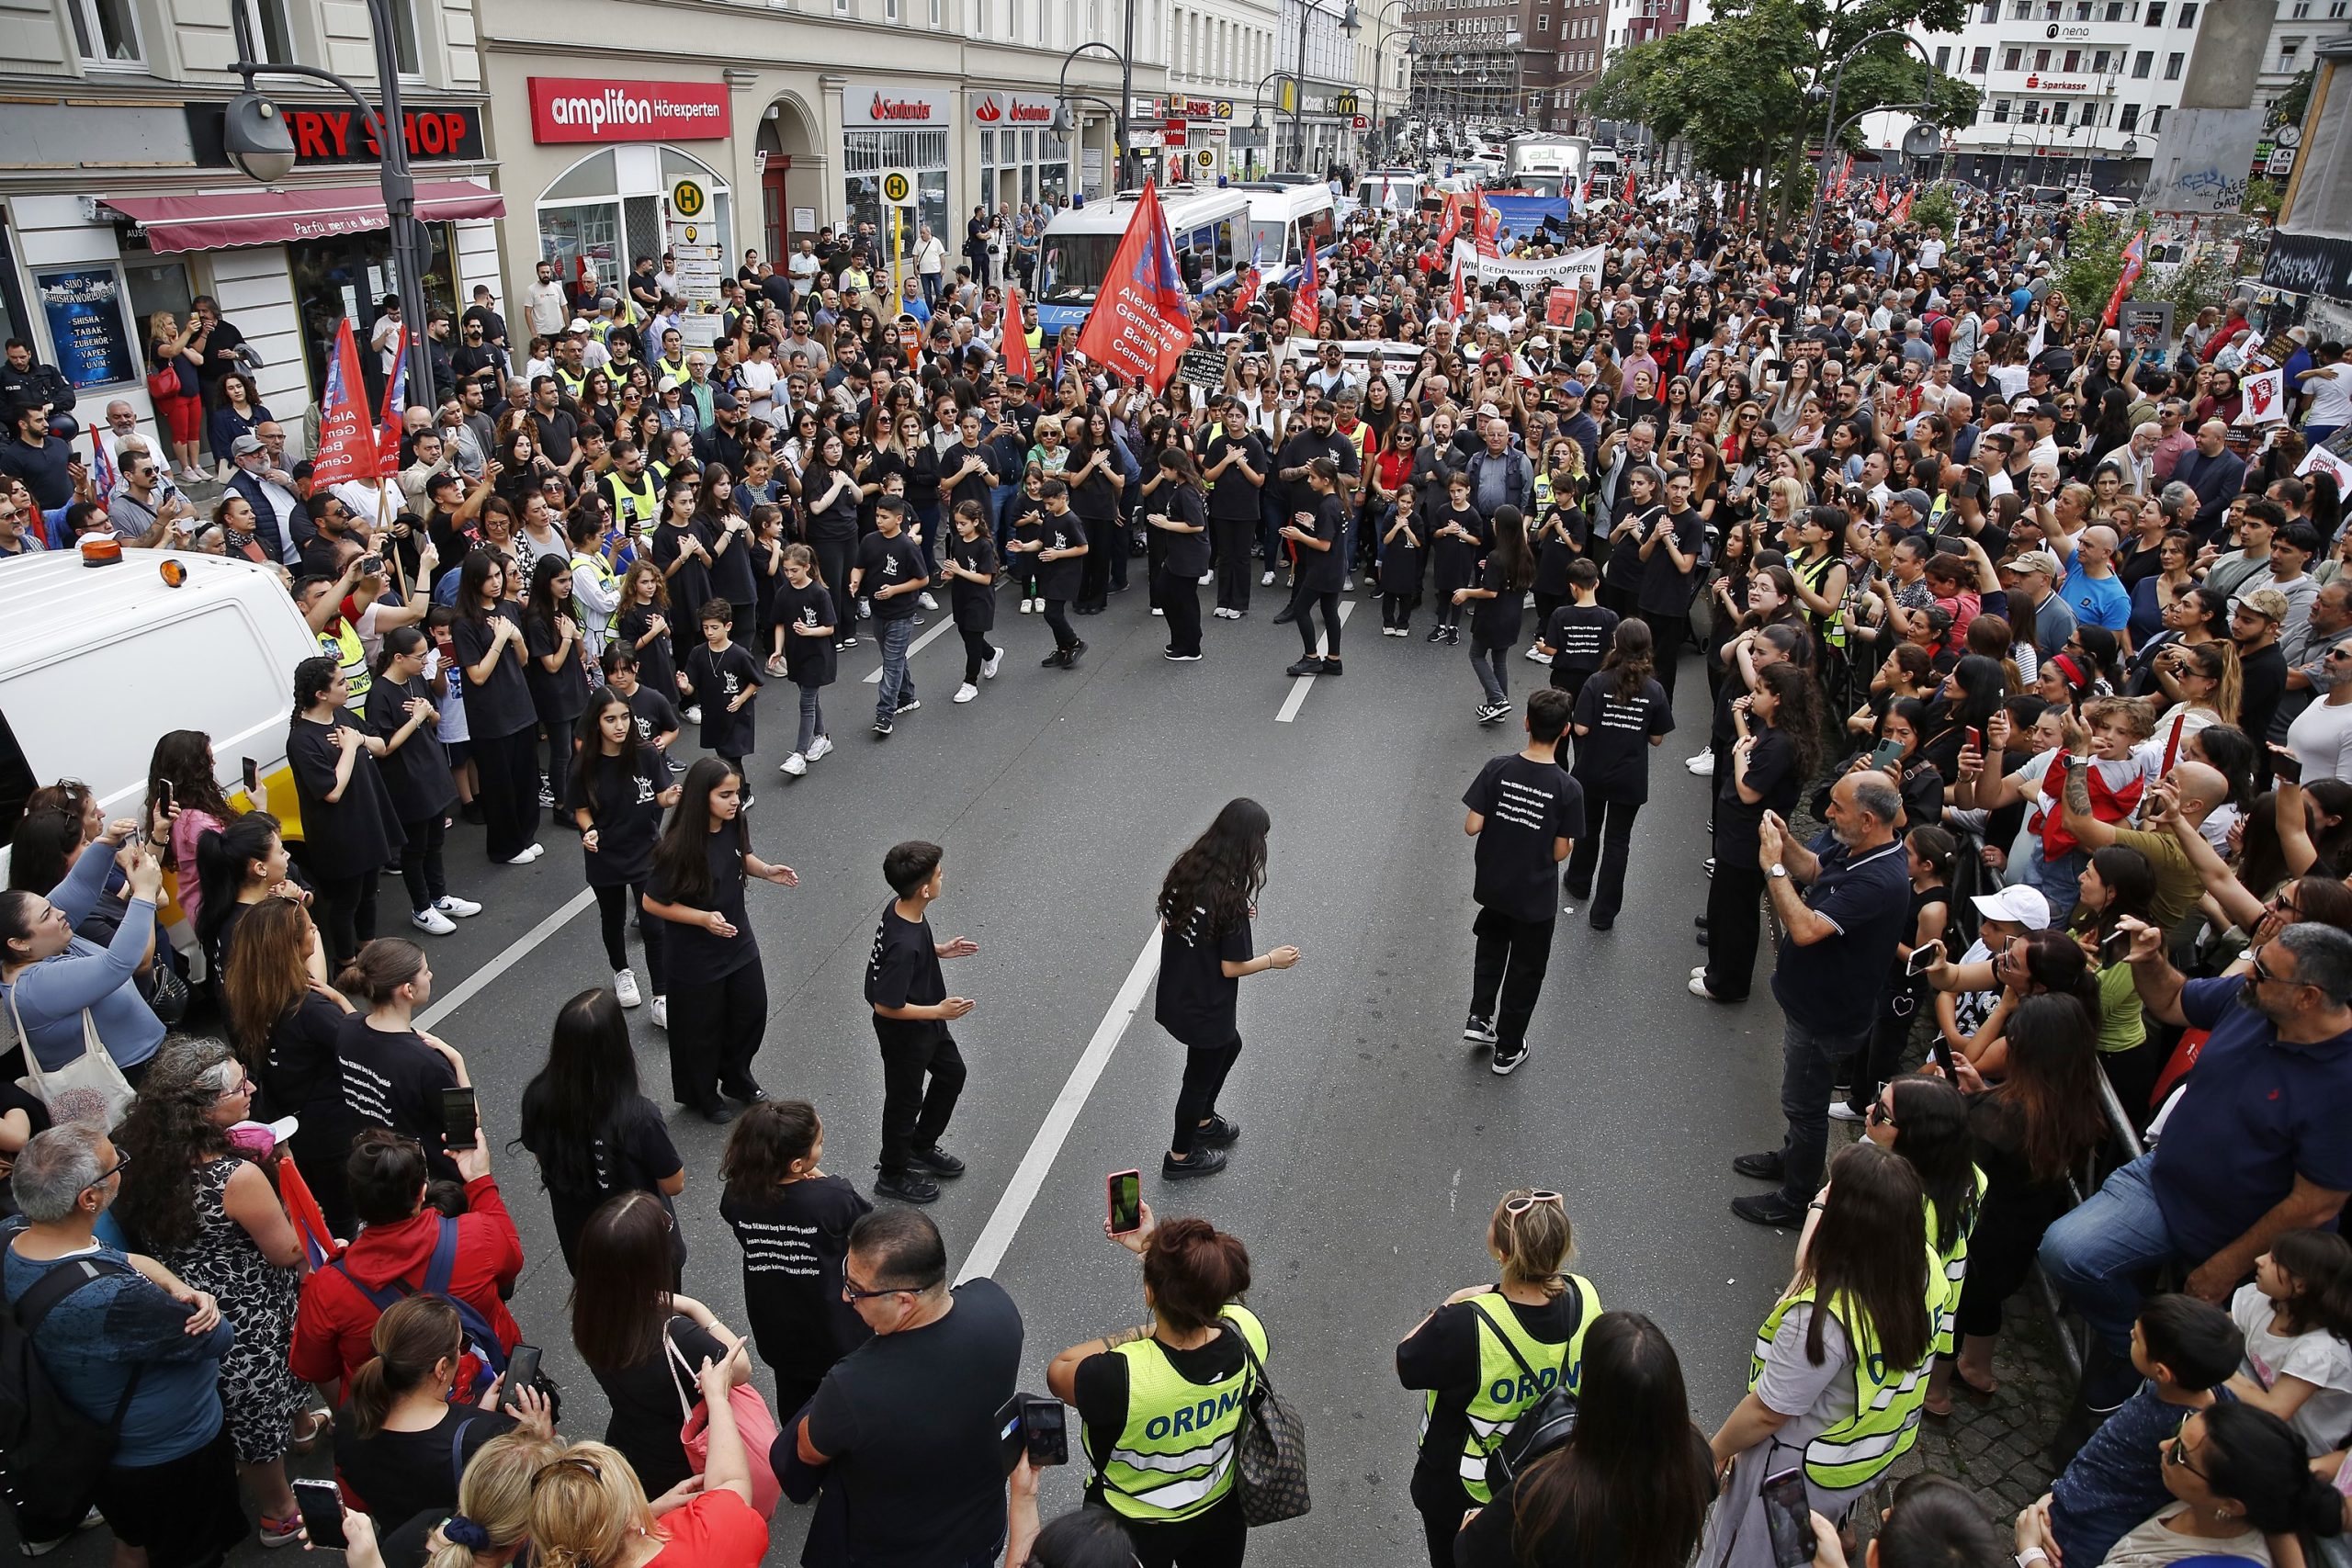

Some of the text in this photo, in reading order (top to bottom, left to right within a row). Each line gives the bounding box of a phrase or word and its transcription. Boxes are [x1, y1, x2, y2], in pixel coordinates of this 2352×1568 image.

[2041, 81, 2086, 90] Sparkasse
[551, 88, 720, 134] amplifon Hörexperten
[884, 98, 932, 119] Santander
[1018, 103, 1051, 121] Santander
[1202, 154, 1209, 163] H
[889, 179, 901, 195] H
[2217, 178, 2247, 199] FREE
[680, 189, 695, 209] H
[2213, 194, 2245, 209] GAZA
[1482, 265, 1533, 276] GEDENKEN
[1536, 267, 1556, 276] DEN
[1559, 264, 1597, 275] OPFERN
[72, 315, 100, 326] SHISHA
[74, 326, 103, 337] TABAK
[73, 335, 109, 348] ZUBEHÖR
[1124, 325, 1158, 358] Berlin
[81, 348, 107, 359] VAPES
[1112, 337, 1157, 374] Cemevi
[2315, 453, 2338, 468] BOYUN
[801, 1268, 820, 1276] dönüyor
